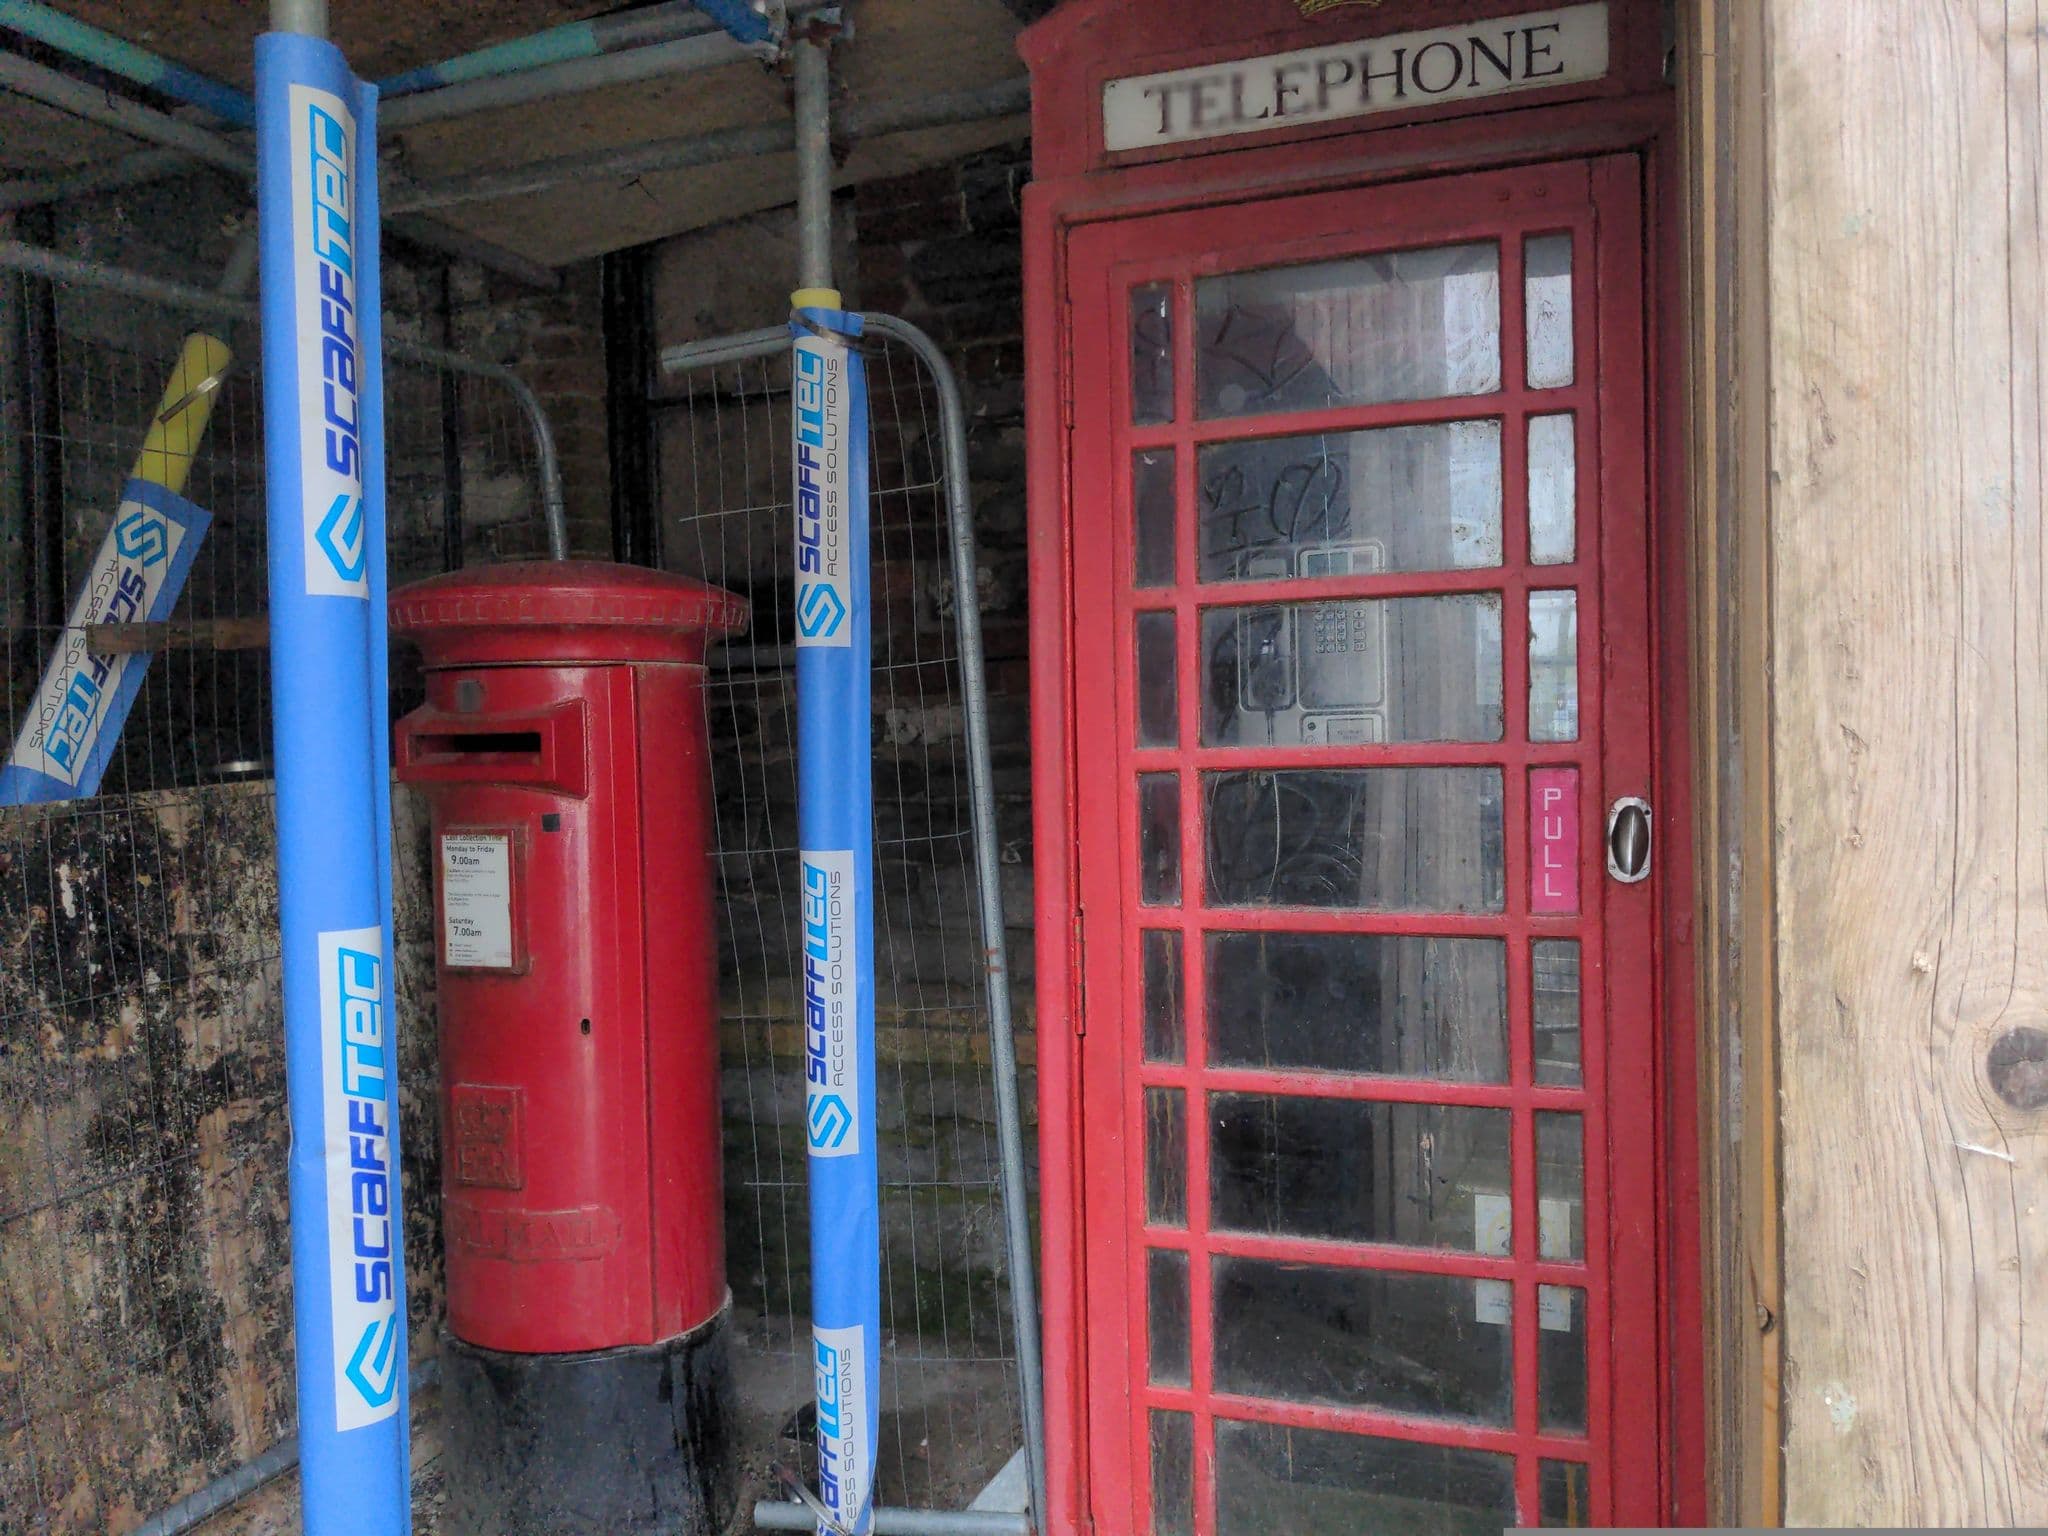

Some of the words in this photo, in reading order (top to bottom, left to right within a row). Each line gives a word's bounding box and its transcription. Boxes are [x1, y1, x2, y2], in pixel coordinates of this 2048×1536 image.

[1144, 23, 1564, 134] TELEPHONE
[826, 357, 838, 484] SOLUTIONS
[826, 490, 838, 577] ACCESS
[80, 558, 118, 632] ACCESS
[30, 637, 85, 749] SOLUTIONS
[446, 845, 468, 853] Monday
[477, 845, 495, 854] Friday
[451, 855, 480, 865] 9.00am
[1543, 787, 1562, 897] PULL
[448, 917, 474, 926] Saturday
[453, 926, 482, 937] 7.00am
[830, 870, 843, 995] SOLUTIONS
[831, 1000, 844, 1087] ACCESS
[840, 1347, 855, 1473] SOLUTIONS
